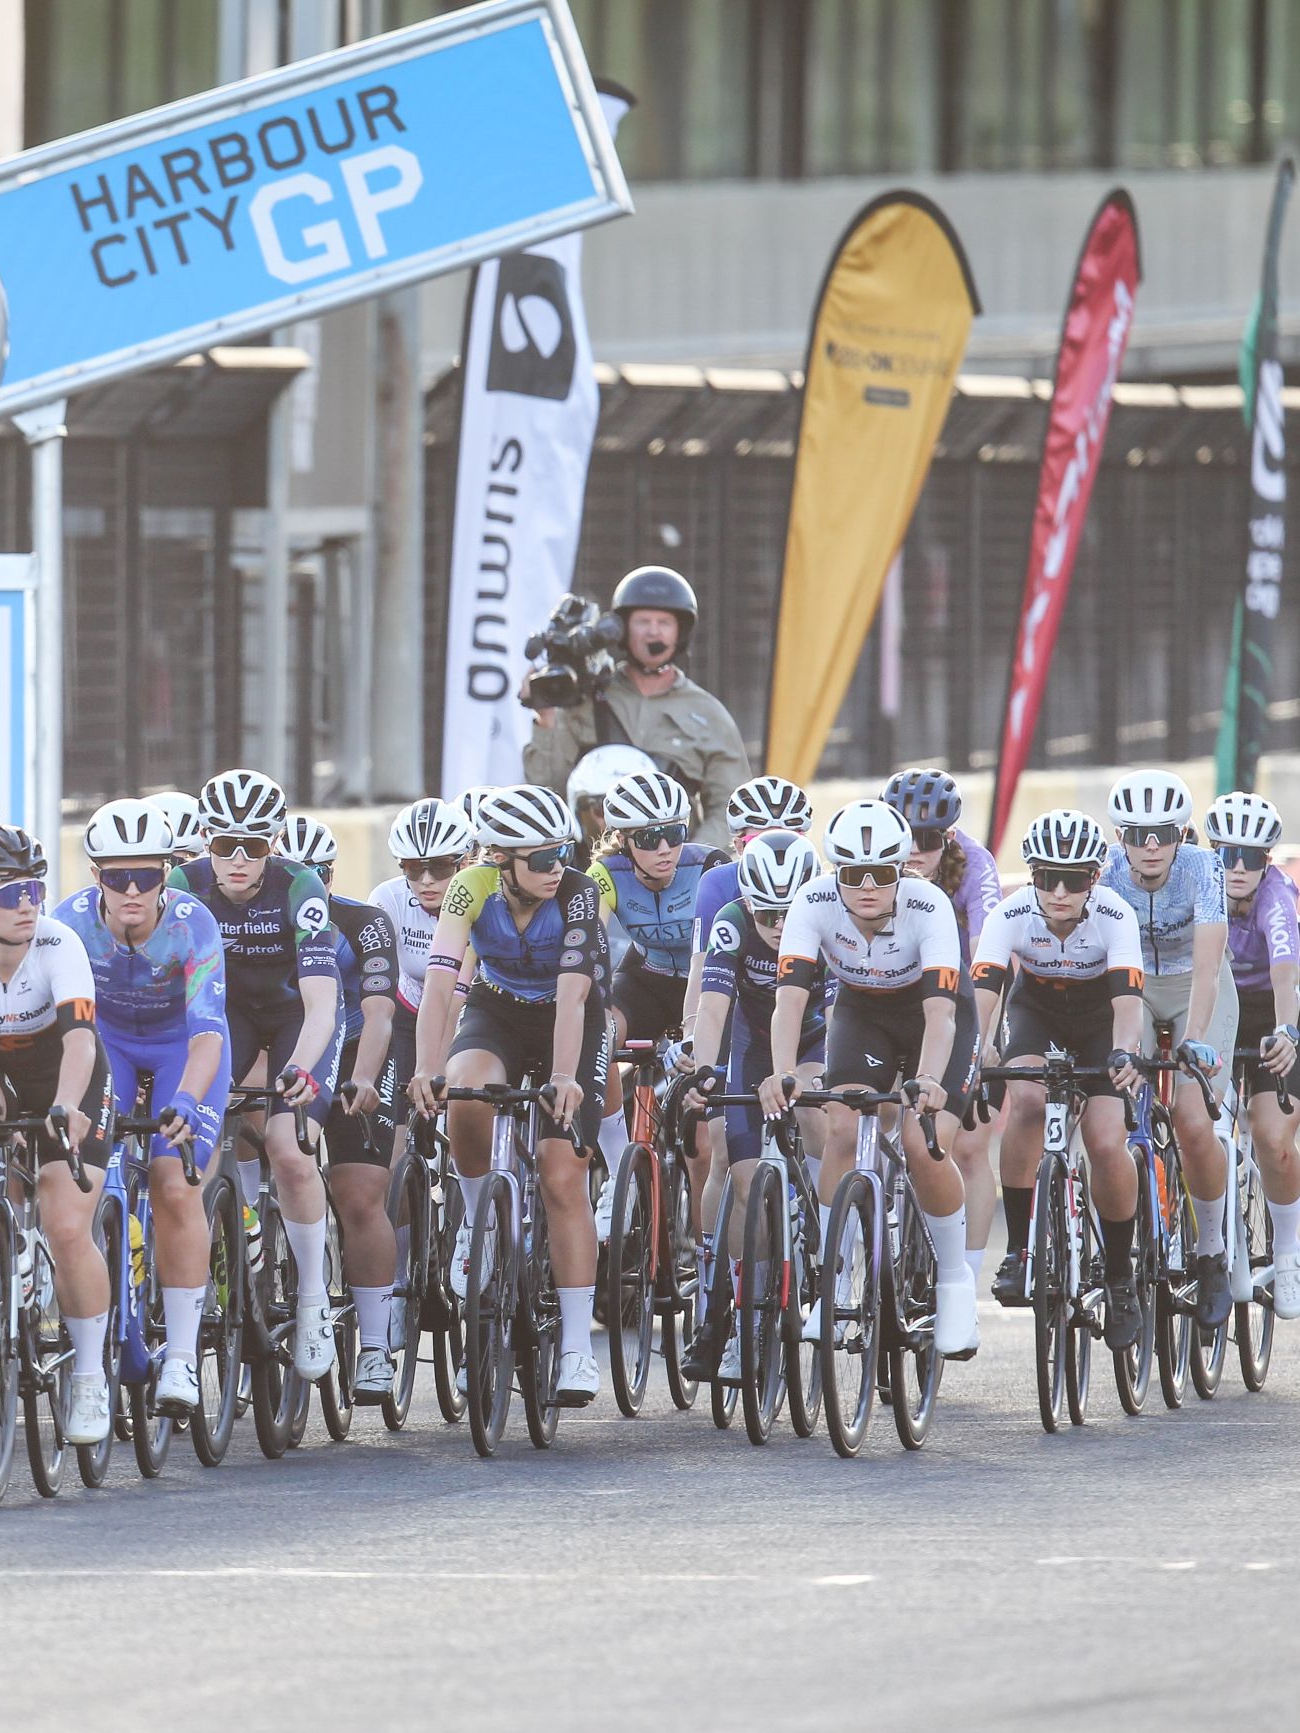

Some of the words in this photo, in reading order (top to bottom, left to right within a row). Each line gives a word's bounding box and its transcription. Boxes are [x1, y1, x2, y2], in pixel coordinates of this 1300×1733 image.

[70, 85, 407, 232] HARBOUR
[249, 144, 424, 285] GP
[91, 195, 239, 288] CITY
[467, 437, 523, 702] sumup
[448, 885, 474, 917] BBB
[567, 893, 585, 923] BBB
[584, 887, 595, 920] cycling
[806, 892, 838, 903] BOMAD
[906, 899, 936, 914] BOMAD
[1004, 904, 1031, 919] BOMAD
[1096, 904, 1124, 920] BOMAD
[359, 924, 382, 953] BBB
[374, 917, 392, 948] cycling
[400, 926, 434, 941] Maillot
[403, 936, 431, 950] Jaune
